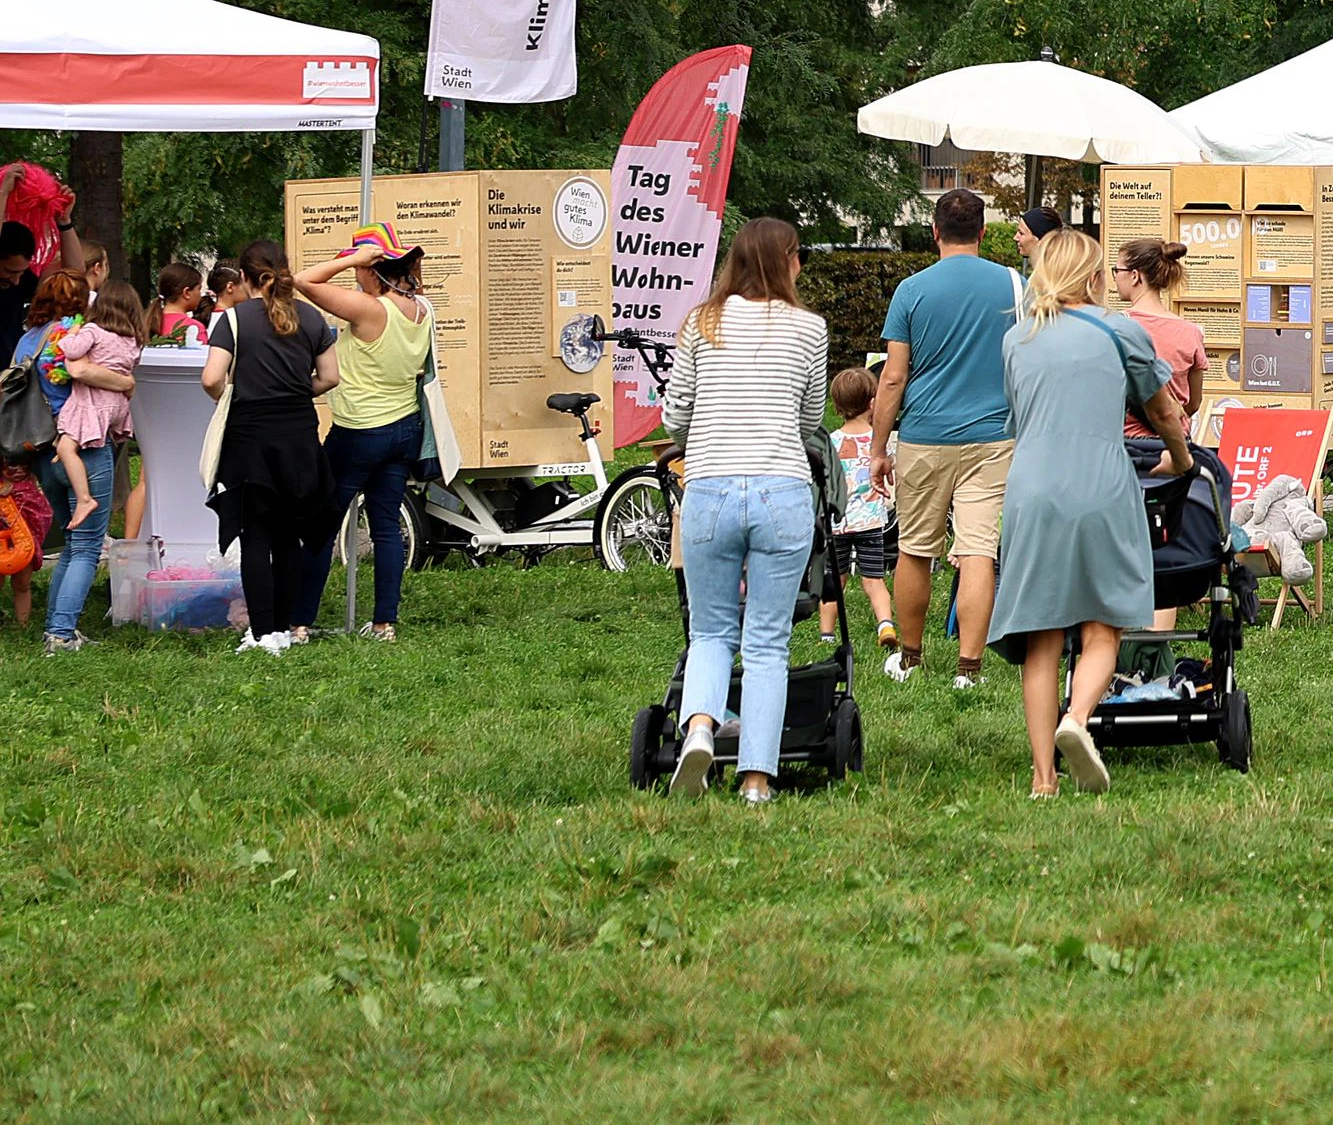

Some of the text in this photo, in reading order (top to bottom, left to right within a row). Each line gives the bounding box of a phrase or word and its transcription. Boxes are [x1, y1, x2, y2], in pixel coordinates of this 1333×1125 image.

[443, 65, 472, 78] Stadt
[442, 76, 472, 89] Wien
[298, 119, 343, 127] MASTERTENT
[627, 164, 671, 196] Tag
[1109, 182, 1152, 190] Die Welt auf
[488, 189, 505, 200] Die
[571, 187, 590, 199] Wien
[1109, 192, 1162, 200] deinem Teller?!
[396, 198, 462, 209] Woran erkennen wir
[302, 206, 316, 214] Was
[317, 206, 344, 214] versteht
[397, 209, 456, 220] den Klimawandel?
[488, 204, 541, 215] Klimakrise
[564, 204, 587, 215] gutes
[620, 198, 665, 223] des
[321, 216, 335, 224] dem
[336, 214, 359, 225] Begriff
[488, 218, 525, 229] und wir
[569, 214, 592, 226] Klima
[616, 231, 704, 258] Wiener
[611, 264, 693, 290] Wohn-
[612, 354, 635, 363] Stadt
[490, 440, 508, 449] Stadt
[490, 450, 508, 458] Wien
[1257, 446, 1273, 480] ORF 2
[1232, 446, 1259, 500] UTE
